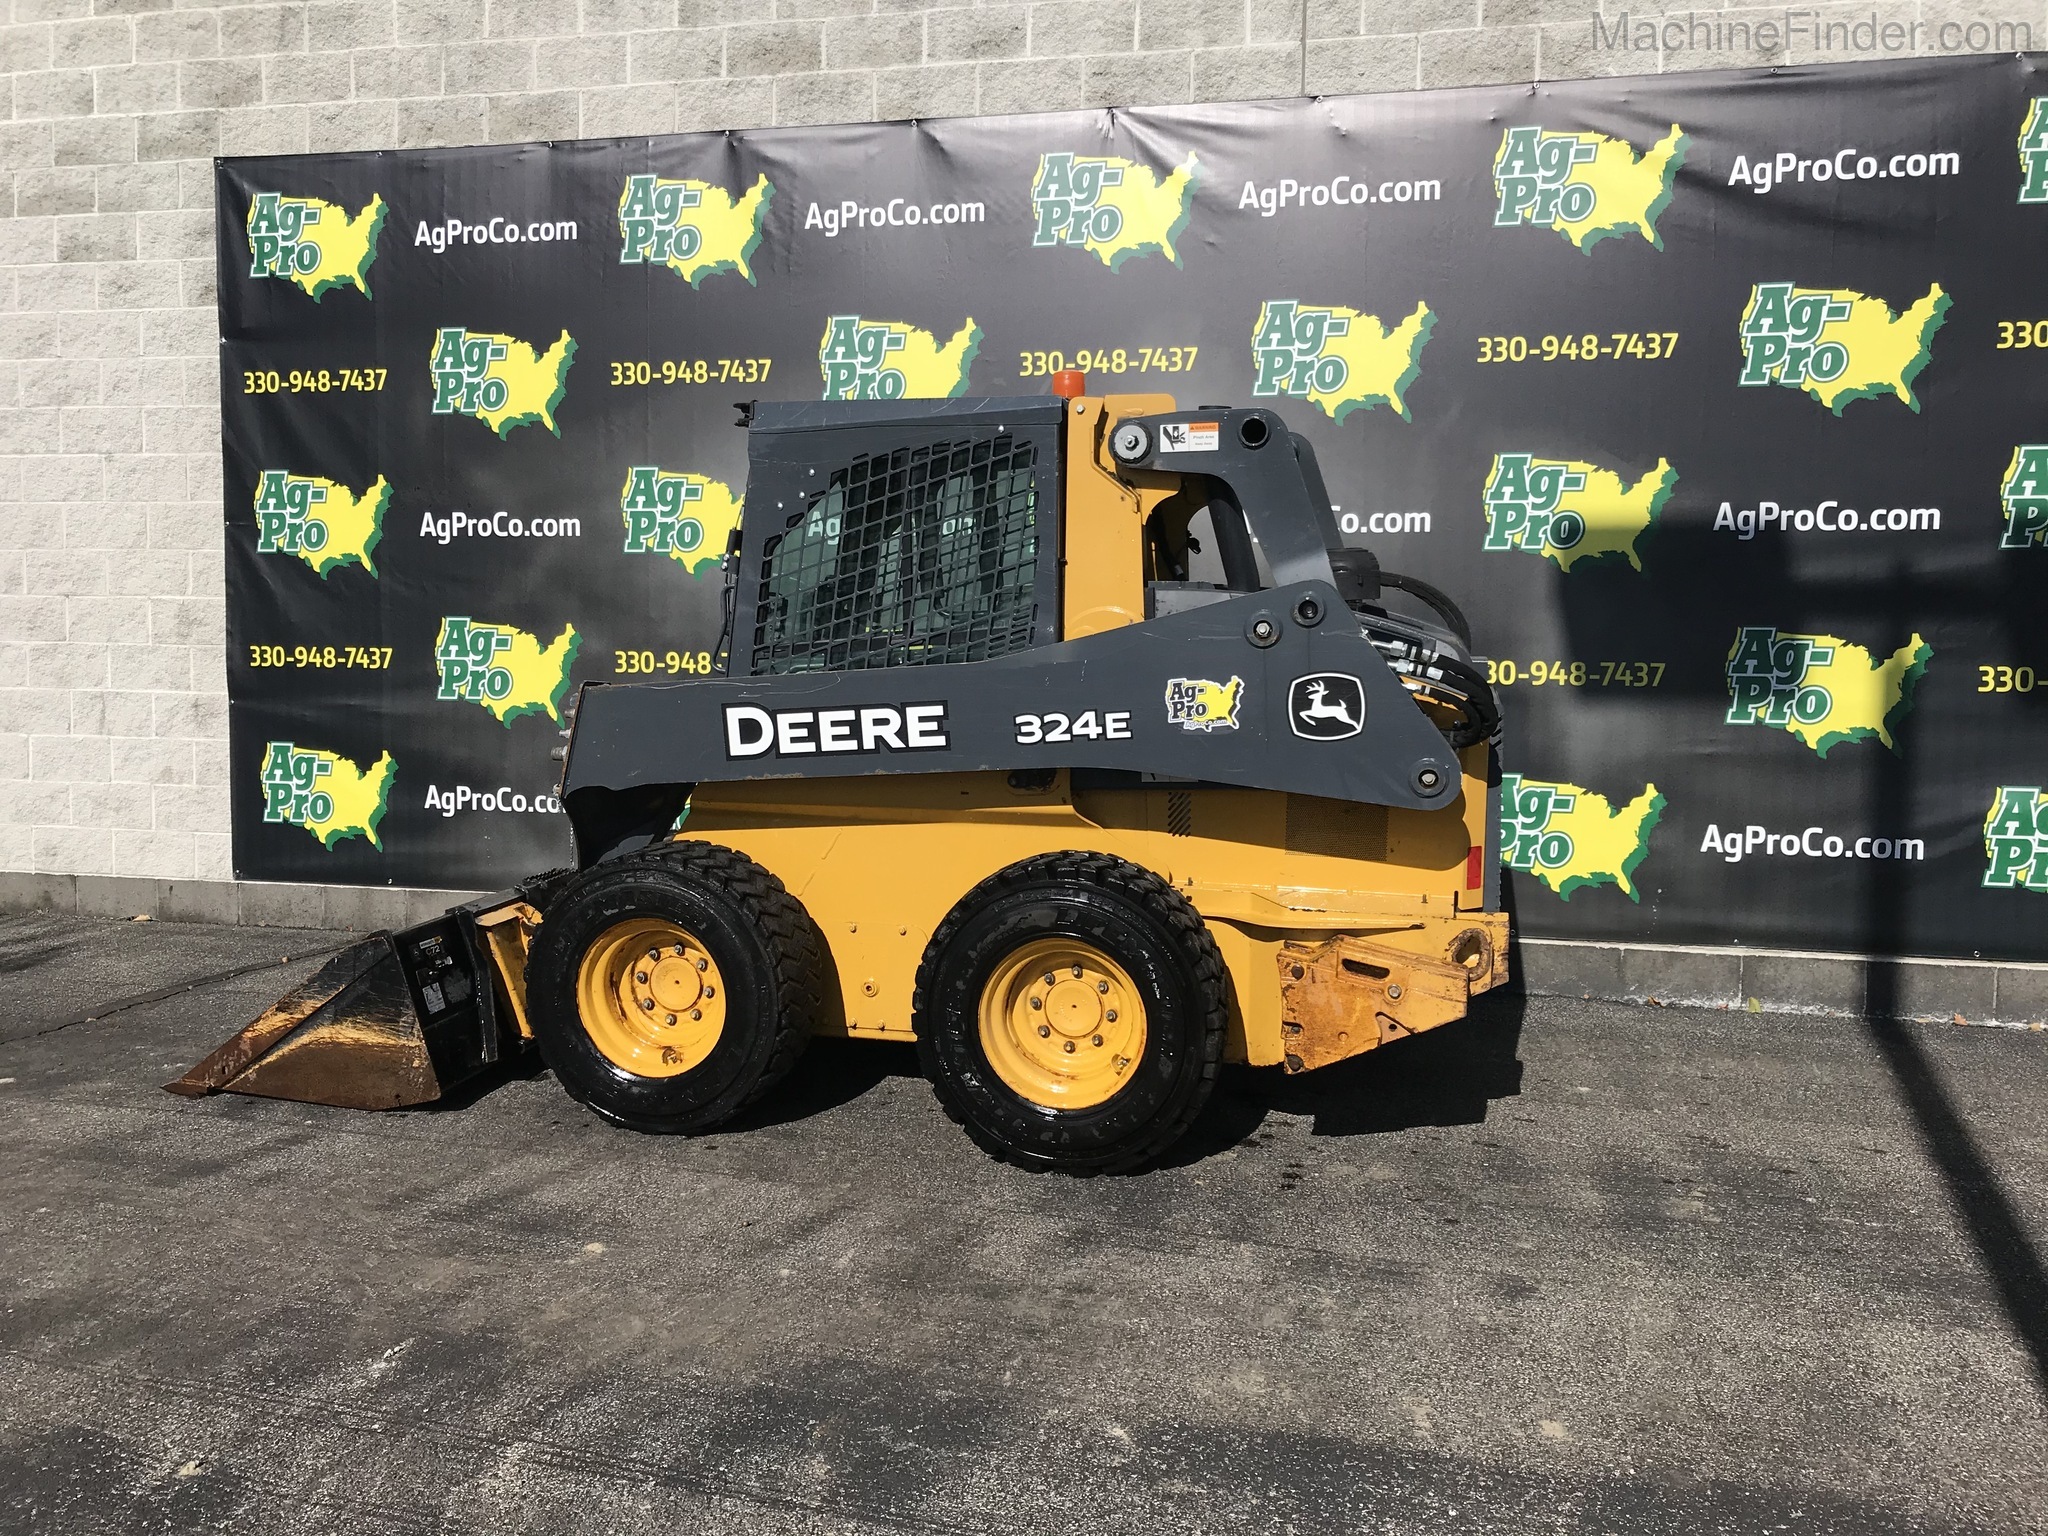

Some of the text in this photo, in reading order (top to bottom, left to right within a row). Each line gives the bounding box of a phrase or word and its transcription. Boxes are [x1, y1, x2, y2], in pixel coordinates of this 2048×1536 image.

[1495, 125, 1597, 189] Ag-
[1728, 149, 1959, 193] AgProCo.com
[621, 174, 702, 231] Ag-
[1034, 152, 1124, 212] Ag-
[1239, 176, 1441, 217] AgProCo.com
[1494, 175, 1597, 227] Pro
[249, 192, 321, 246] Ag-
[414, 217, 577, 253] AgProCo.com
[805, 199, 984, 236] AgProCo.com
[1033, 199, 1124, 247] Pro
[248, 234, 321, 278] Pro
[620, 218, 702, 264] Pro
[1254, 300, 1350, 360] Ag-
[1740, 282, 1851, 347] Ag-
[431, 328, 507, 382] Ag-
[822, 315, 905, 370] Ag-
[1020, 347, 1198, 376] 330-948-7437
[1478, 332, 1679, 363] 330-948-7437
[1739, 332, 1851, 385] Pro
[243, 368, 388, 394] 330-948-7437
[430, 370, 507, 413] Pro
[611, 358, 772, 386] 330-948-7437
[822, 361, 905, 400] Pro
[1253, 347, 1350, 396] Pro
[257, 471, 328, 522] Ag-
[624, 467, 702, 521] Ag-
[1484, 454, 1585, 514] Ag-
[256, 511, 328, 552] Pro
[420, 512, 581, 545] AgProCo.com
[623, 509, 702, 552] Pro
[1483, 501, 1585, 550] Pro
[1713, 500, 1941, 539] AgProCo.com
[250, 646, 393, 670] 330-948-7437
[436, 617, 511, 669] Ag-
[1727, 627, 1834, 688] Ag-
[435, 657, 511, 699] Pro
[1169, 680, 1206, 705] Ag-
[1726, 675, 1834, 724] Pro
[726, 704, 946, 758] DEERE
[1016, 711, 1132, 745] 324E
[1169, 700, 1208, 720] Pro
[1185, 718, 1228, 729] AgProCo.com
[262, 742, 333, 792] Ag-
[261, 781, 333, 822] Pro
[424, 784, 567, 818] AgProCo.co
[1700, 824, 1925, 863] AgProCo.com
